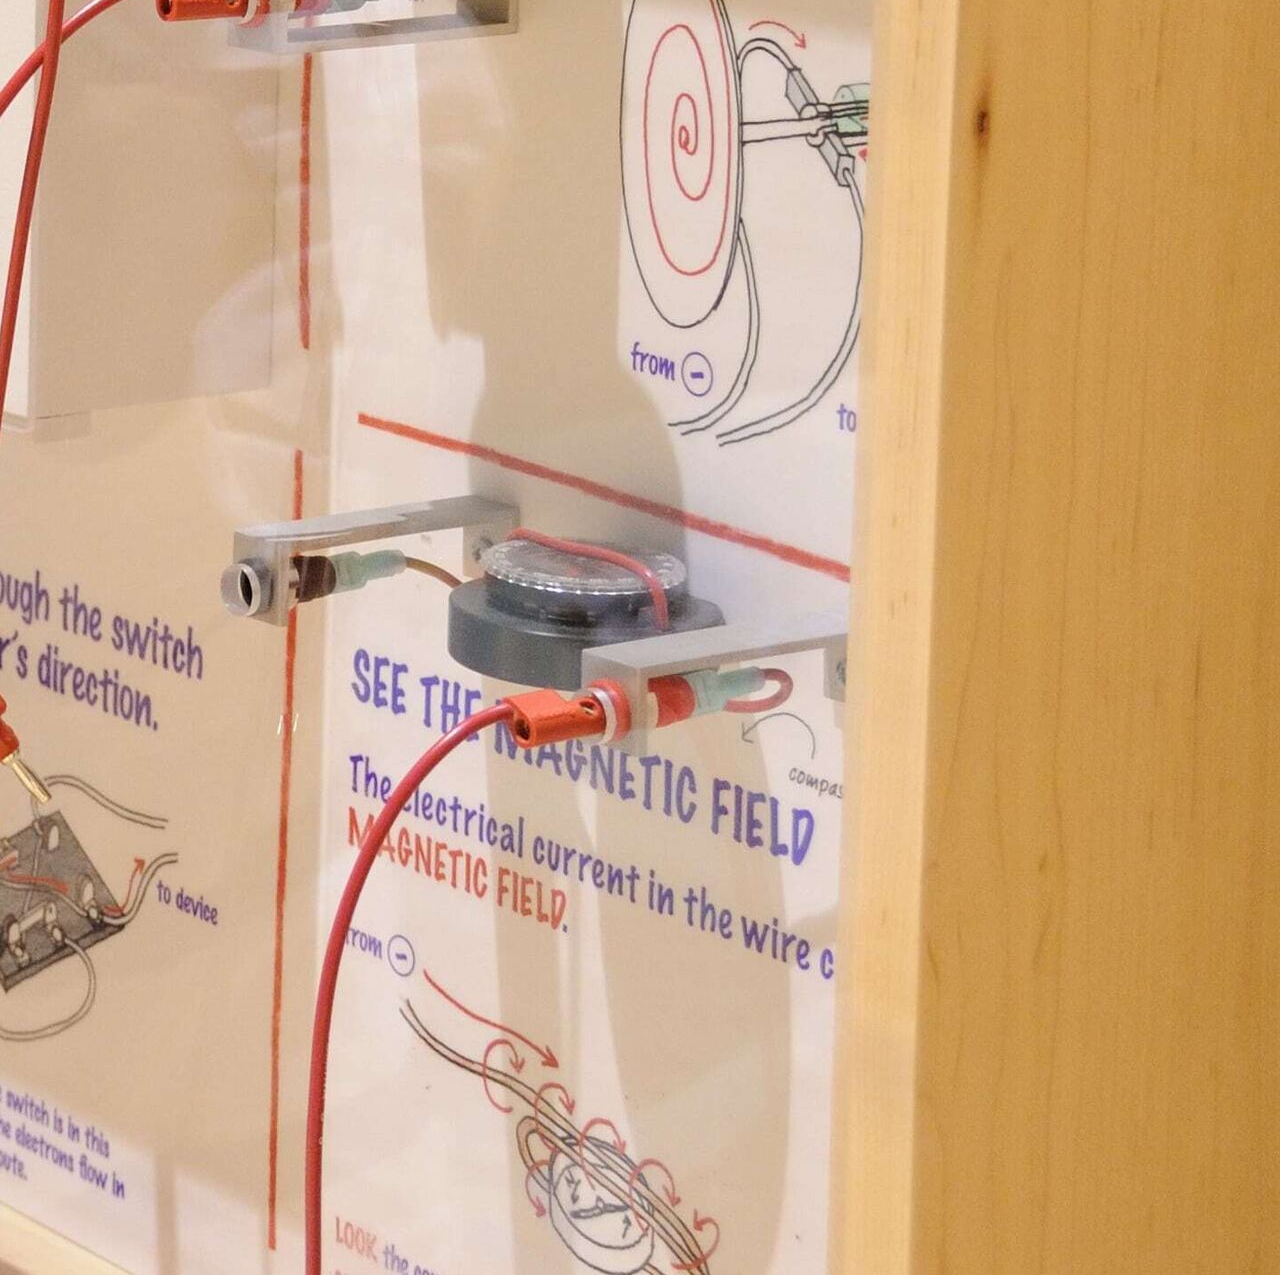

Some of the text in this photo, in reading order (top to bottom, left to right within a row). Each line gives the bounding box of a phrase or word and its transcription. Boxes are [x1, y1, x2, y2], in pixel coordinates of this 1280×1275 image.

[630, 341, 676, 382] from
[836, 403, 858, 433] to
[58, 583, 103, 643] the
[111, 614, 204, 681] switch
[36, 642, 159, 732] direction.
[351, 648, 409, 715] SEE
[419, 675, 482, 743] THE
[710, 777, 816, 866] FIELD
[156, 879, 219, 927] to device
[349, 754, 835, 981] The lectrical current in the wire c
[496, 866, 568, 933] FIELD.
[6, 1089, 50, 1127] switch
[53, 1107, 64, 1135] is
[67, 1114, 81, 1144] in
[85, 1125, 111, 1160] this
[14, 1122, 75, 1174] electrons
[78, 1152, 109, 1191] flow
[111, 1170, 126, 1201] in
[335, 1215, 379, 1264] LOOK
